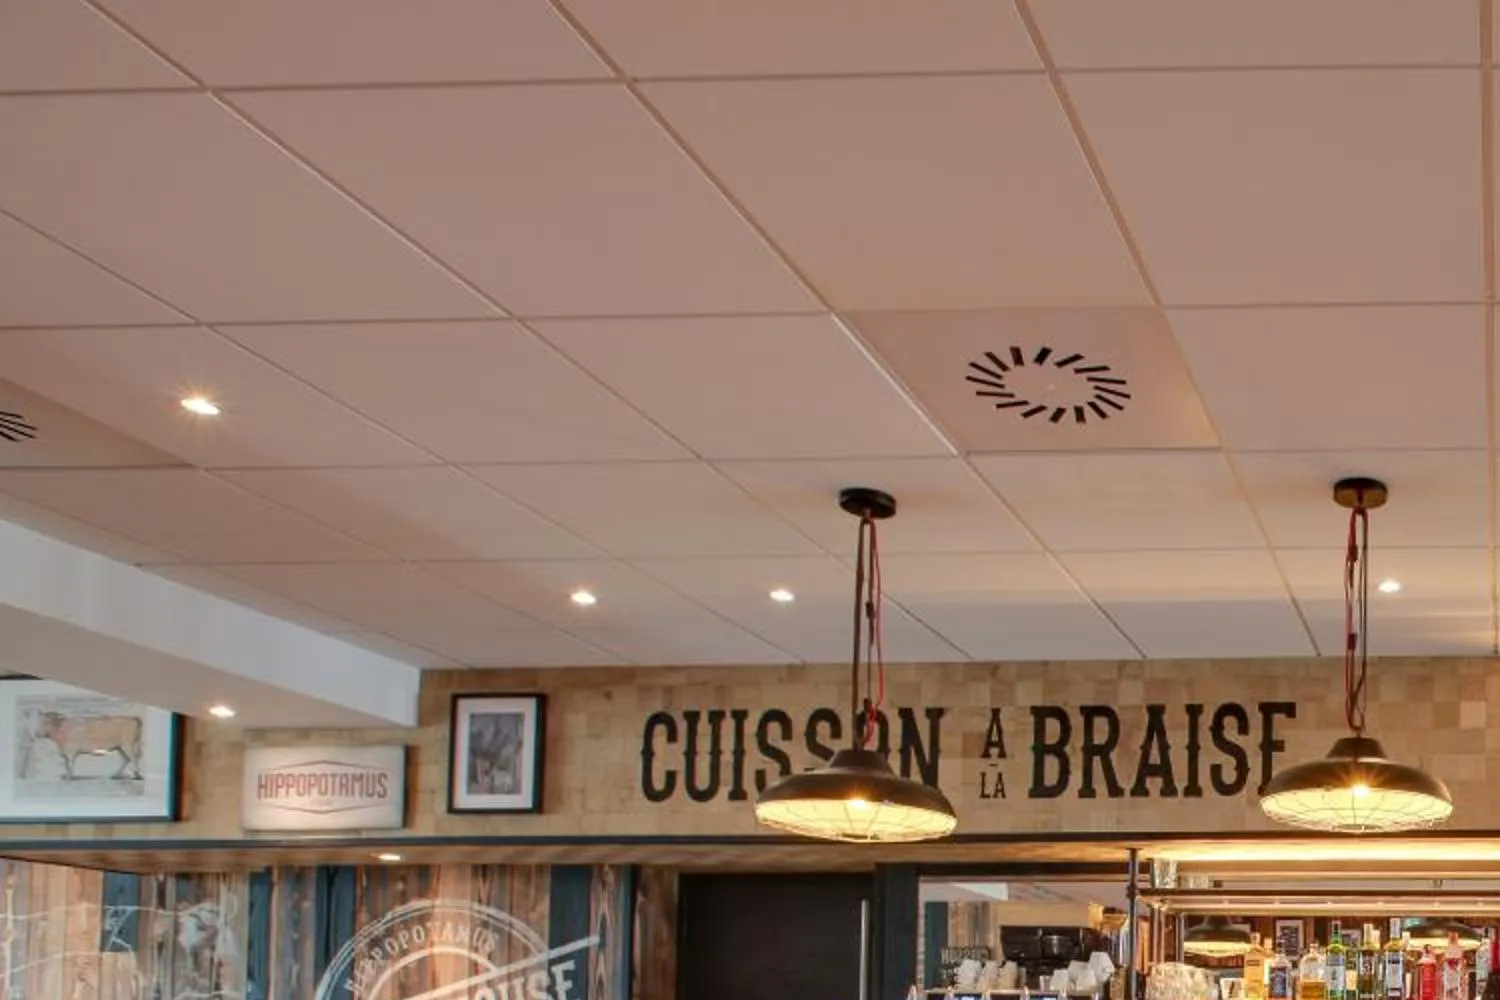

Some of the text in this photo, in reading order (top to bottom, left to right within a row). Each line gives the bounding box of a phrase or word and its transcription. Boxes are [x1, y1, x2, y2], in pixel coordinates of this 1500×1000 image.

[979, 772, 1006, 798] LA
[1028, 702, 1297, 798] BRAISE
[257, 772, 388, 800] HIPPOPOTAMUS
